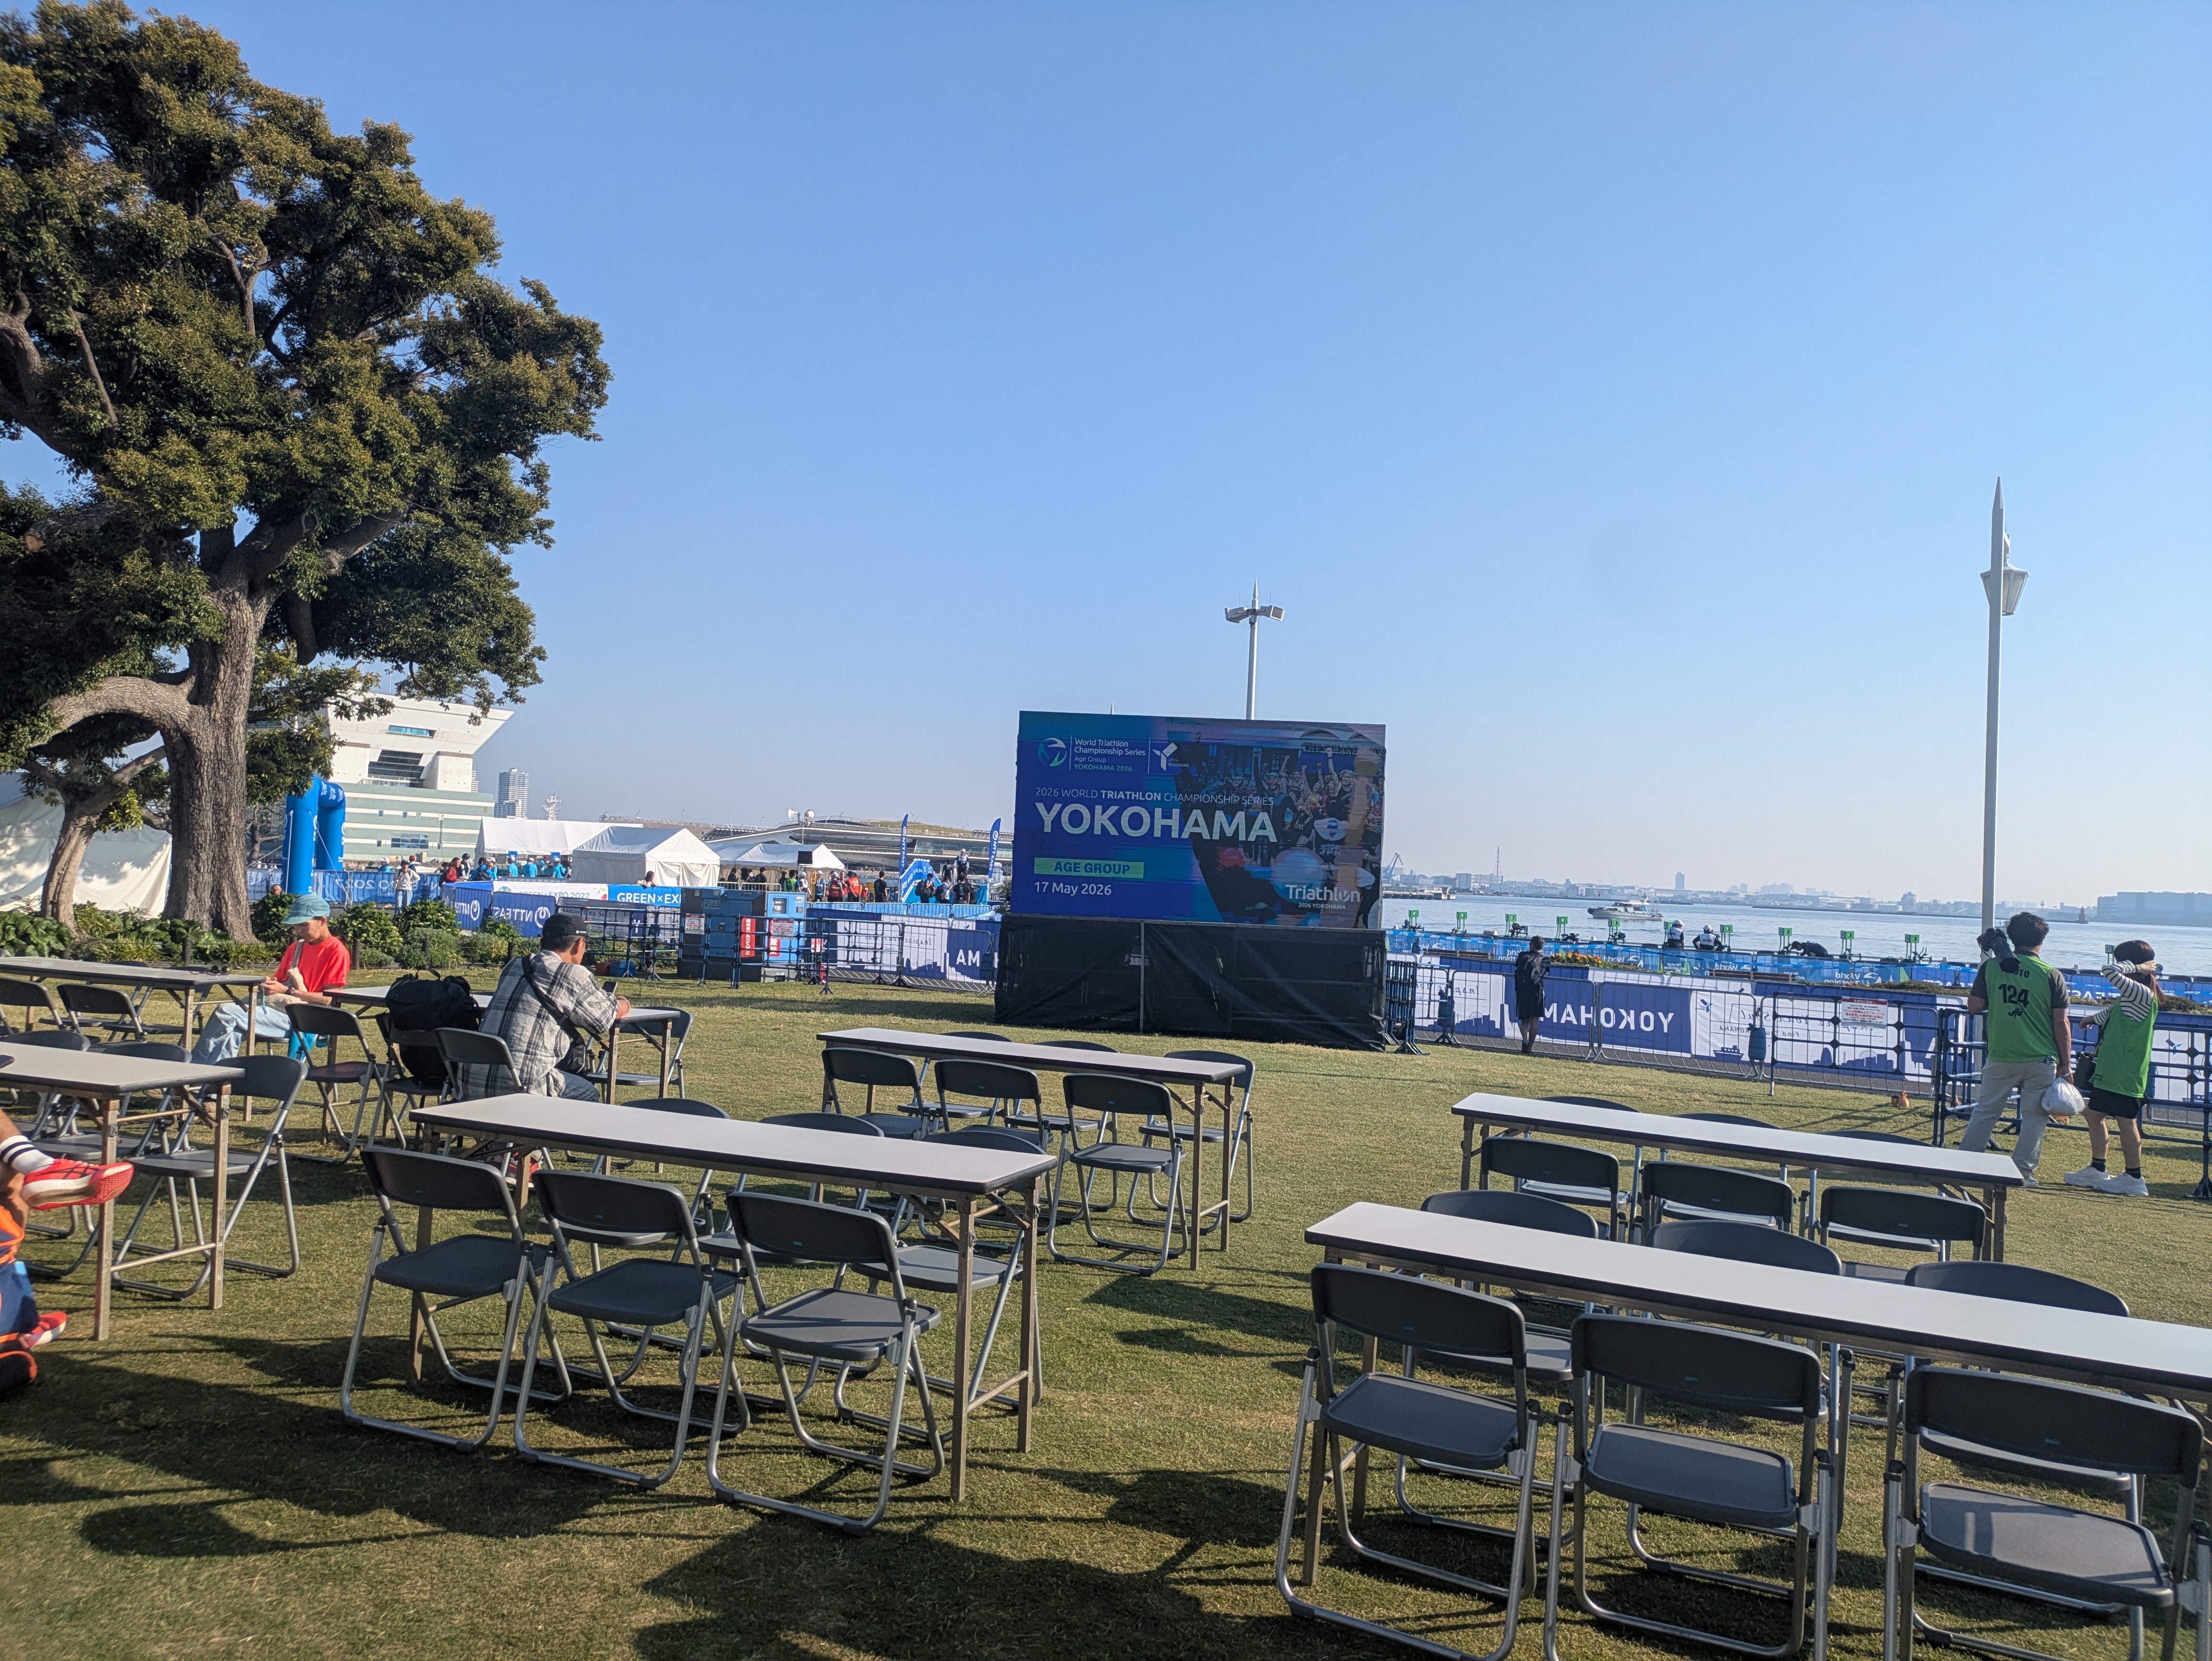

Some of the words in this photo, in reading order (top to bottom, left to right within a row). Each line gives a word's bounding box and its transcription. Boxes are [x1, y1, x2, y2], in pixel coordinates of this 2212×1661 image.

[1074, 747, 1123, 756] Championship
[1036, 787, 1059, 797] 2026
[1062, 788, 1098, 798] WORLD
[1100, 790, 1161, 801] TRIATHLON
[1164, 793, 1239, 804] CHAMPIONSHIP
[1241, 796, 1273, 806] SERIES
[1035, 802, 1278, 842] YOKOHAMA
[1054, 862, 1081, 873] AGE
[1084, 863, 1130, 875] GROUP
[1034, 882, 1049, 892] 17
[1052, 882, 1078, 897] May
[1081, 884, 1112, 896] 2026
[1285, 885, 1360, 902] Triathlon
[1998, 984, 2029, 1008] 124
